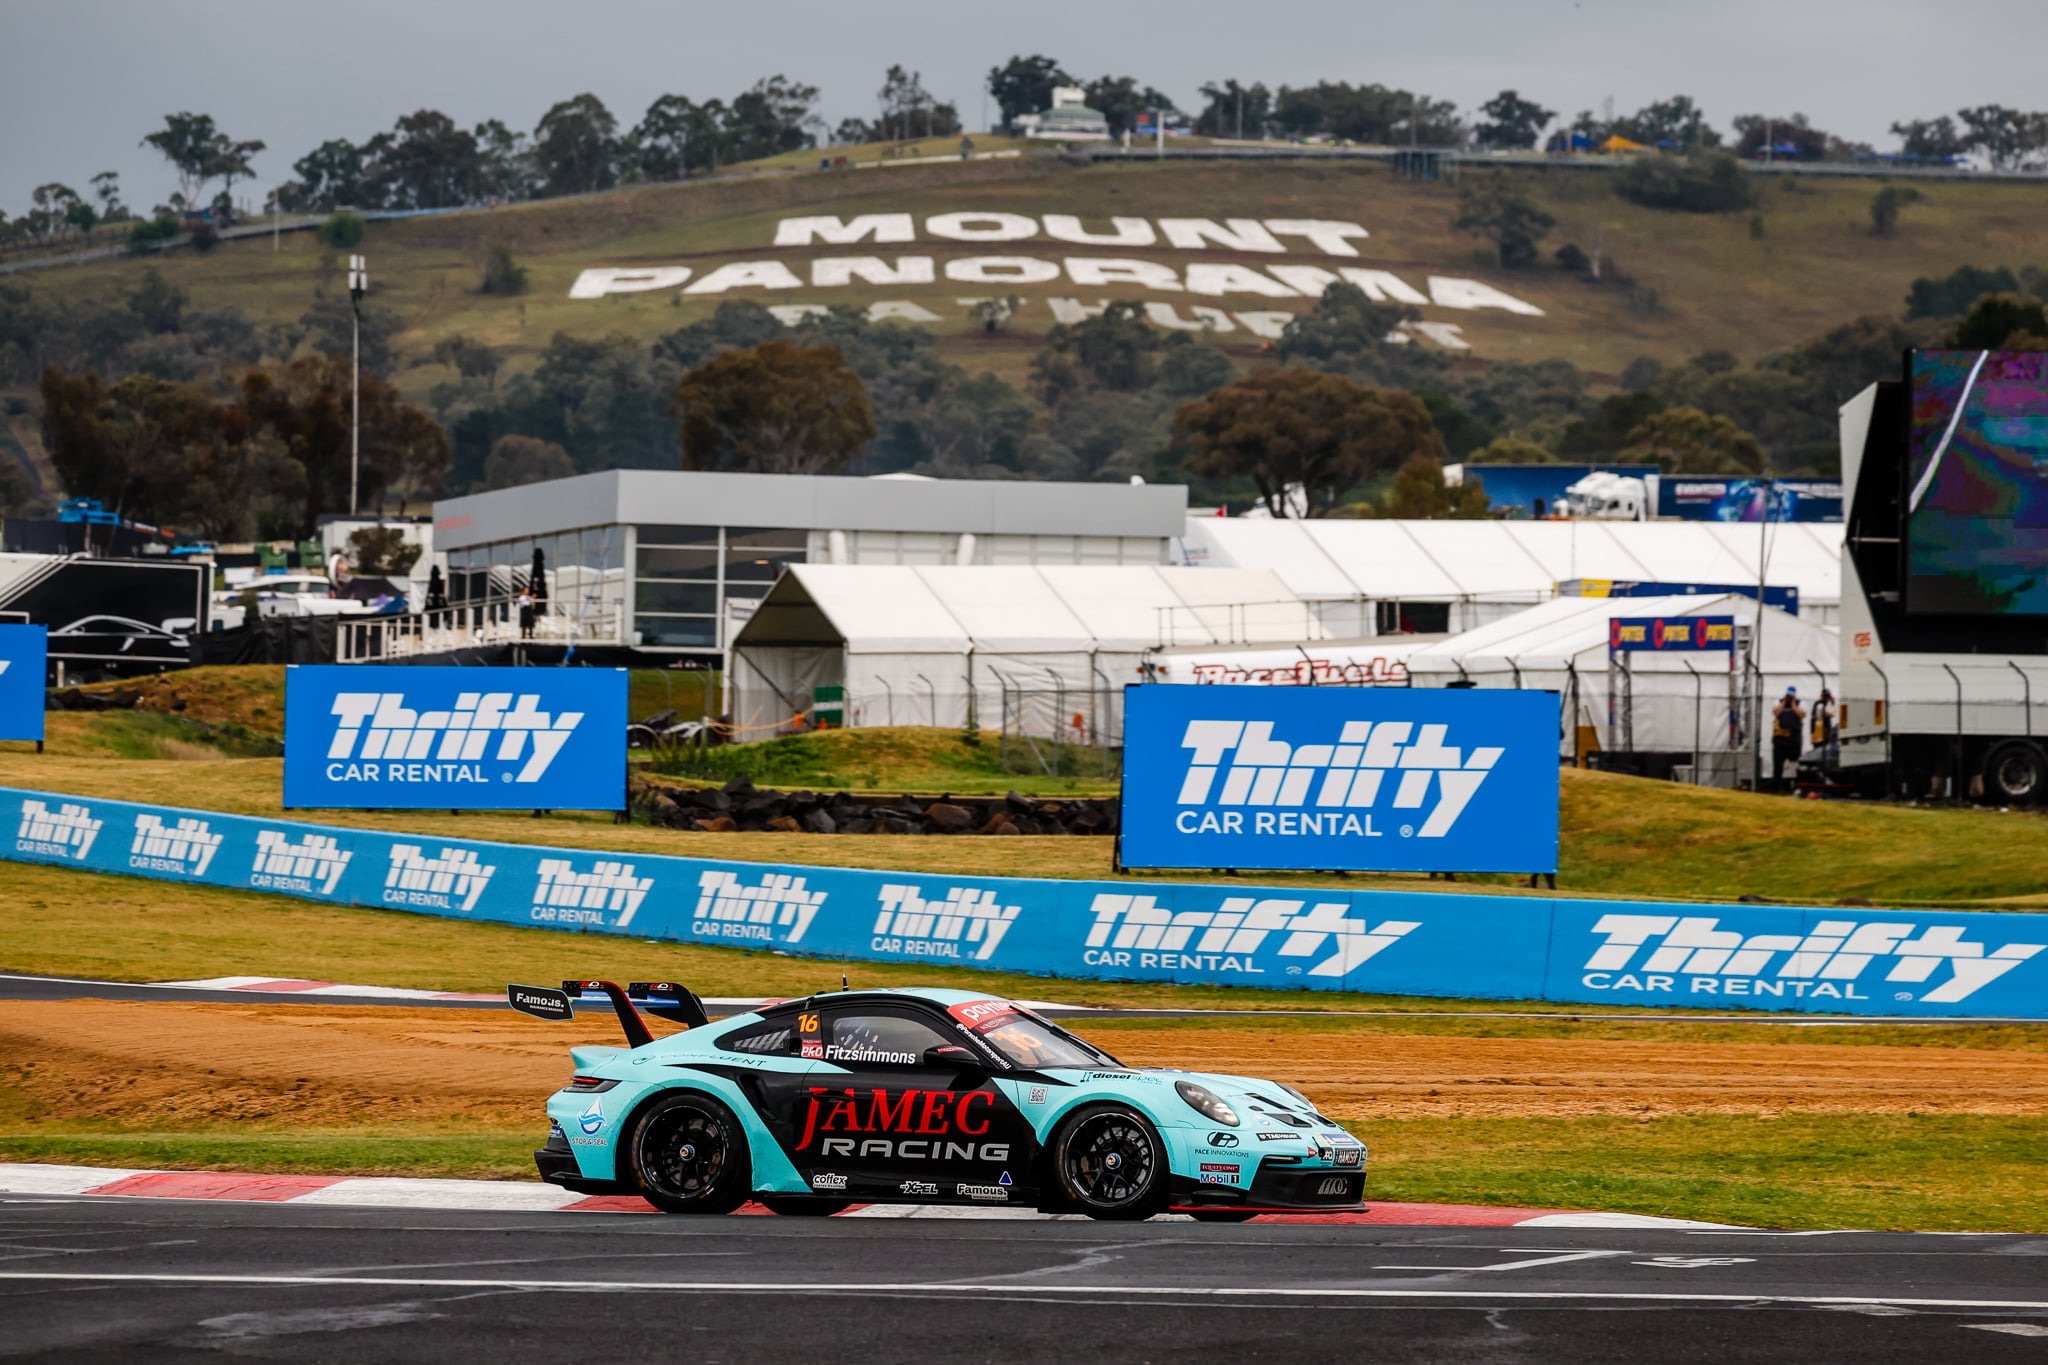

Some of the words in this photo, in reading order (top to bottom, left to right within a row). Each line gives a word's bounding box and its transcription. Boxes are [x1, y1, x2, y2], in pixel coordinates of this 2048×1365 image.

[773, 211, 1369, 257] MOUNT
[568, 256, 1546, 316] PANORAMA
[327, 692, 585, 783] Thrifty
[326, 763, 379, 782] CAR
[388, 764, 489, 783] RENTAL
[1177, 720, 1506, 838] Thrifty
[18, 799, 103, 860] Thrifty
[1176, 811, 1243, 834] CAR
[1256, 812, 1382, 837] RENTAL
[16, 839, 36, 852] CAR
[36, 841, 69, 858] RENTAL
[131, 814, 224, 876] Thrifty
[129, 855, 151, 869] CAR
[151, 858, 185, 874] RENTAL
[252, 830, 354, 895] Thrifty
[251, 874, 273, 888] CAR
[273, 877, 313, 893] RENTAL
[385, 844, 496, 911] Thrifty
[383, 889, 407, 903] CAR
[409, 892, 451, 909] RENTAL
[532, 859, 655, 926] Thrifty
[531, 907, 557, 922] CAR
[558, 909, 604, 925] RENTAL
[694, 870, 829, 943] Thrifty
[692, 921, 720, 936] CAR
[722, 923, 773, 941] RENTAL
[873, 884, 1022, 960] Thrifty
[871, 937, 900, 953] CAR
[905, 940, 960, 958] RENTAL
[1084, 893, 1423, 977] Thrifty
[1084, 950, 1130, 967] CAR
[1140, 953, 1264, 973] RENTAL
[1584, 914, 2047, 1003] Thrifty
[1582, 973, 1674, 992] CAR
[1691, 977, 1869, 1000] RENTAL
[798, 1014, 818, 1033] 16
[825, 1045, 916, 1064] Fitzsimmons
[795, 1087, 995, 1151] JAMEC
[821, 1137, 1010, 1161] RACING
[1211, 1149, 1249, 1158] INNOVATIONS
[813, 1173, 847, 1185] coffex
[957, 1184, 1007, 1197] Famous.
[1201, 1173, 1229, 1184] Mobil
